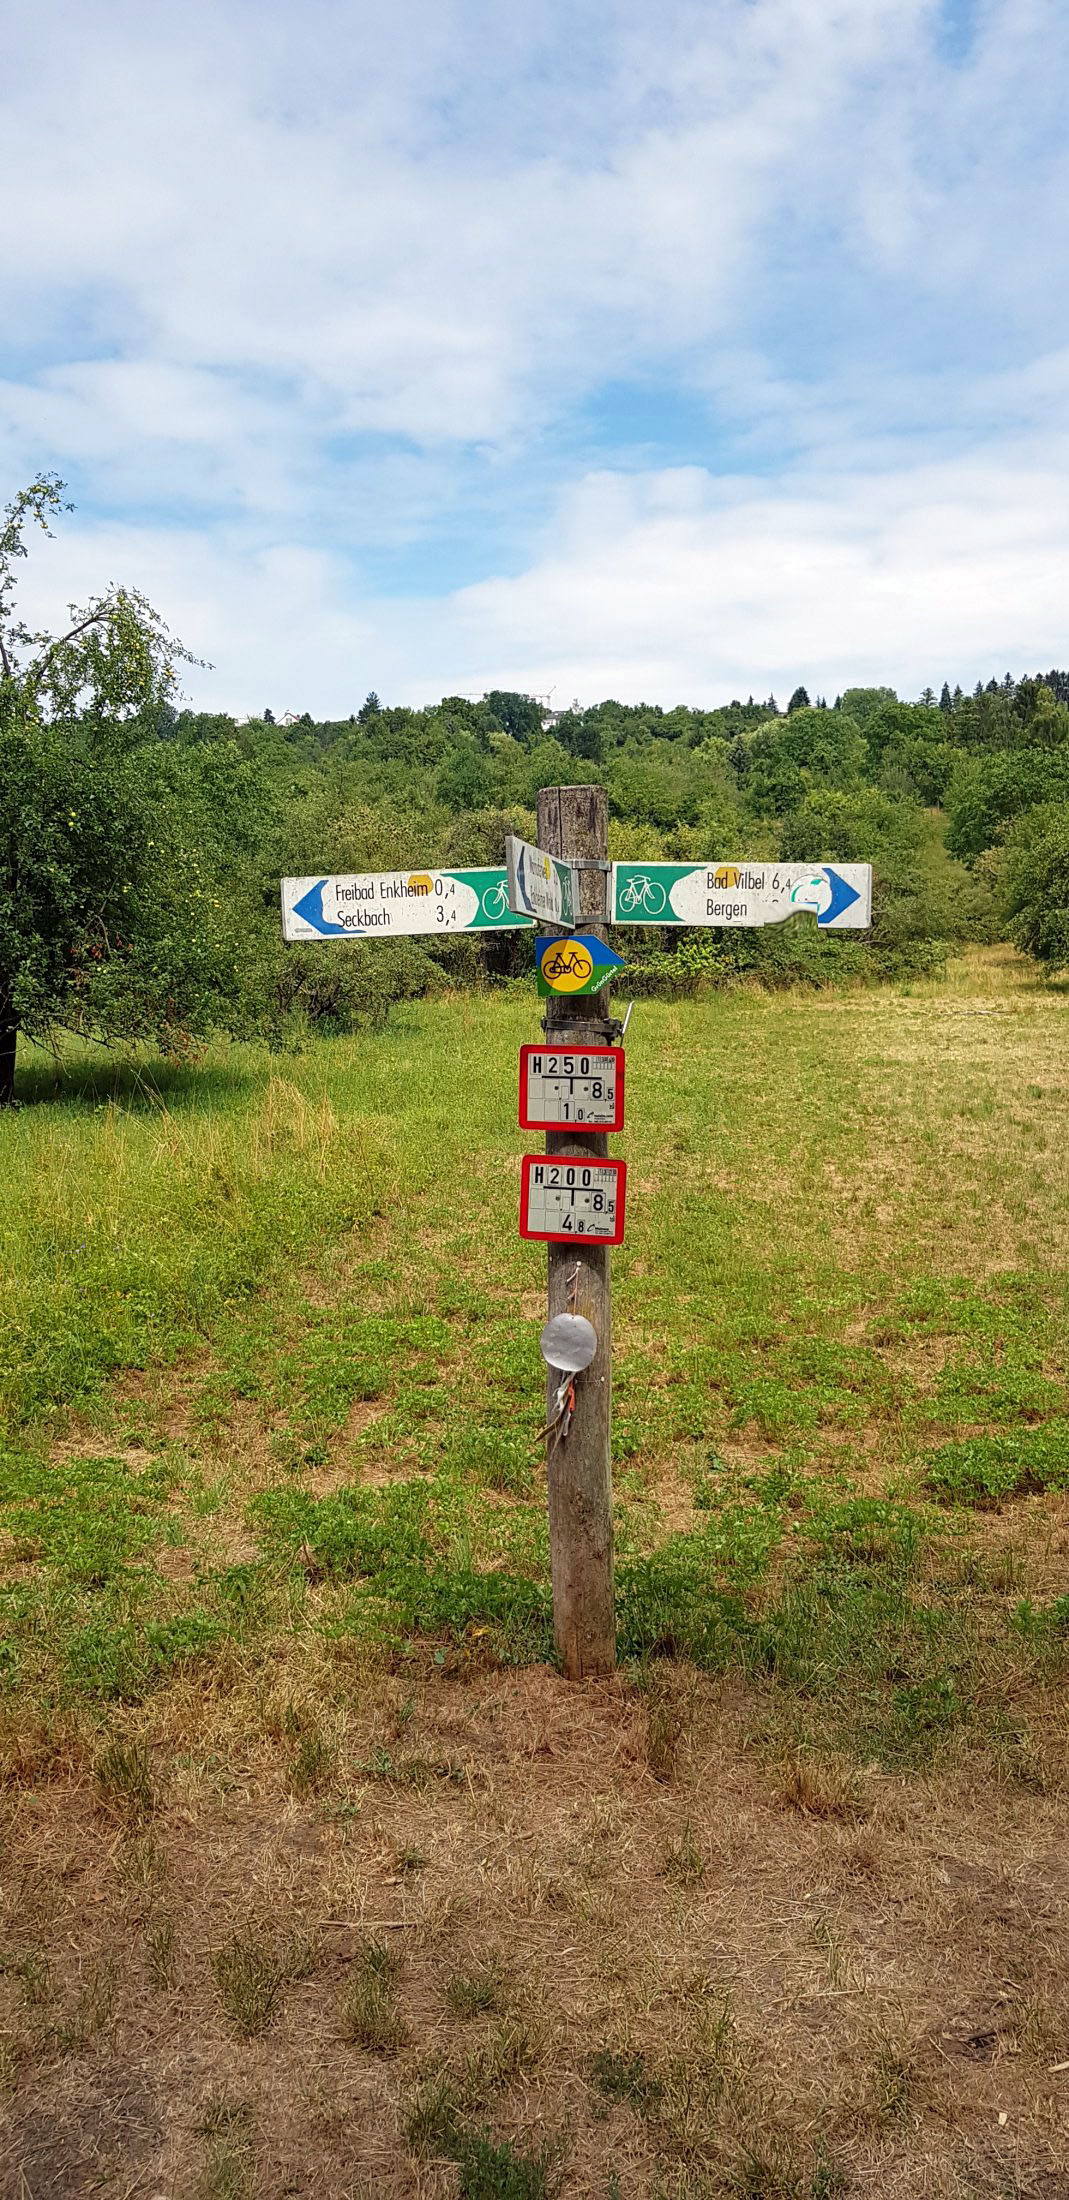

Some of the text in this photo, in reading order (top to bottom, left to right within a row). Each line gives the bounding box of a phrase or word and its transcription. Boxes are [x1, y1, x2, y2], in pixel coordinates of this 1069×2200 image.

[335, 878, 455, 901] Freibad Enkheim 0,4
[707, 872, 791, 893] Bad Vilbel 6,4
[337, 908, 391, 927] Seckbach
[436, 905, 457, 926] 3,4
[706, 899, 747, 920] Bergen
